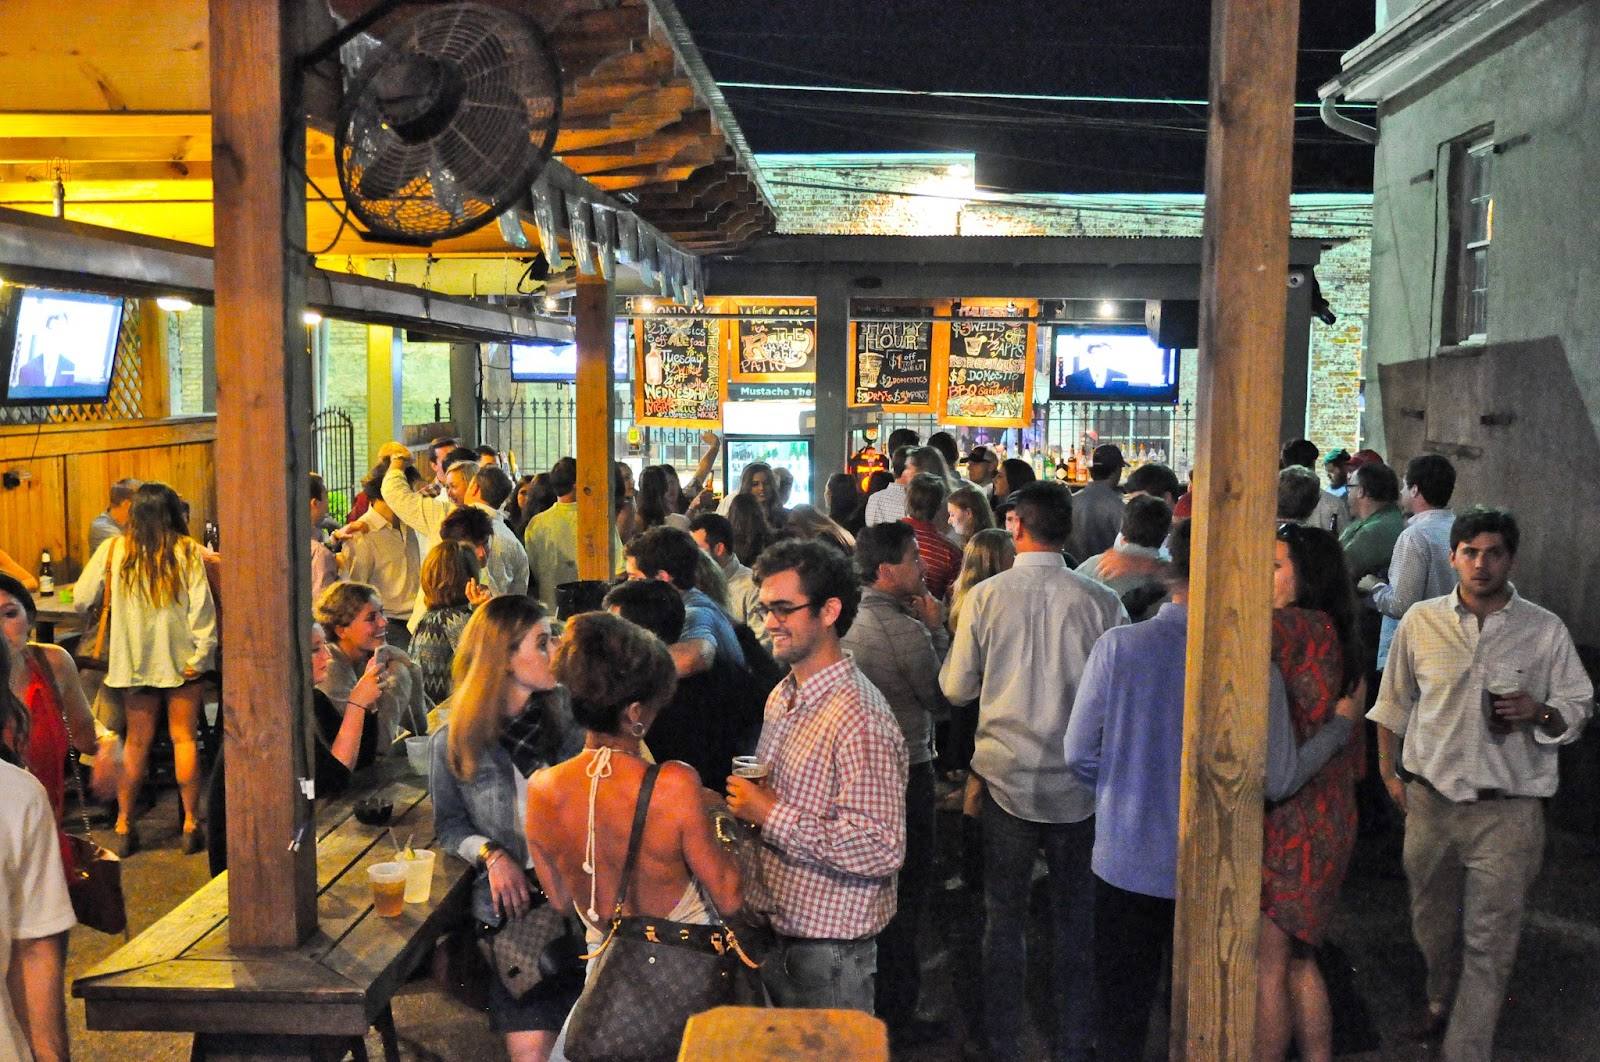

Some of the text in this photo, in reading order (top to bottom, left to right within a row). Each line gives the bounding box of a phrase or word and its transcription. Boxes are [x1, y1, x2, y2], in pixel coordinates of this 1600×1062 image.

[866, 321, 923, 337] HAPPY
[970, 320, 1006, 333] WELLS
[861, 333, 919, 350] HOUR
[740, 387, 812, 396] Mustache The
[653, 427, 673, 443] the
